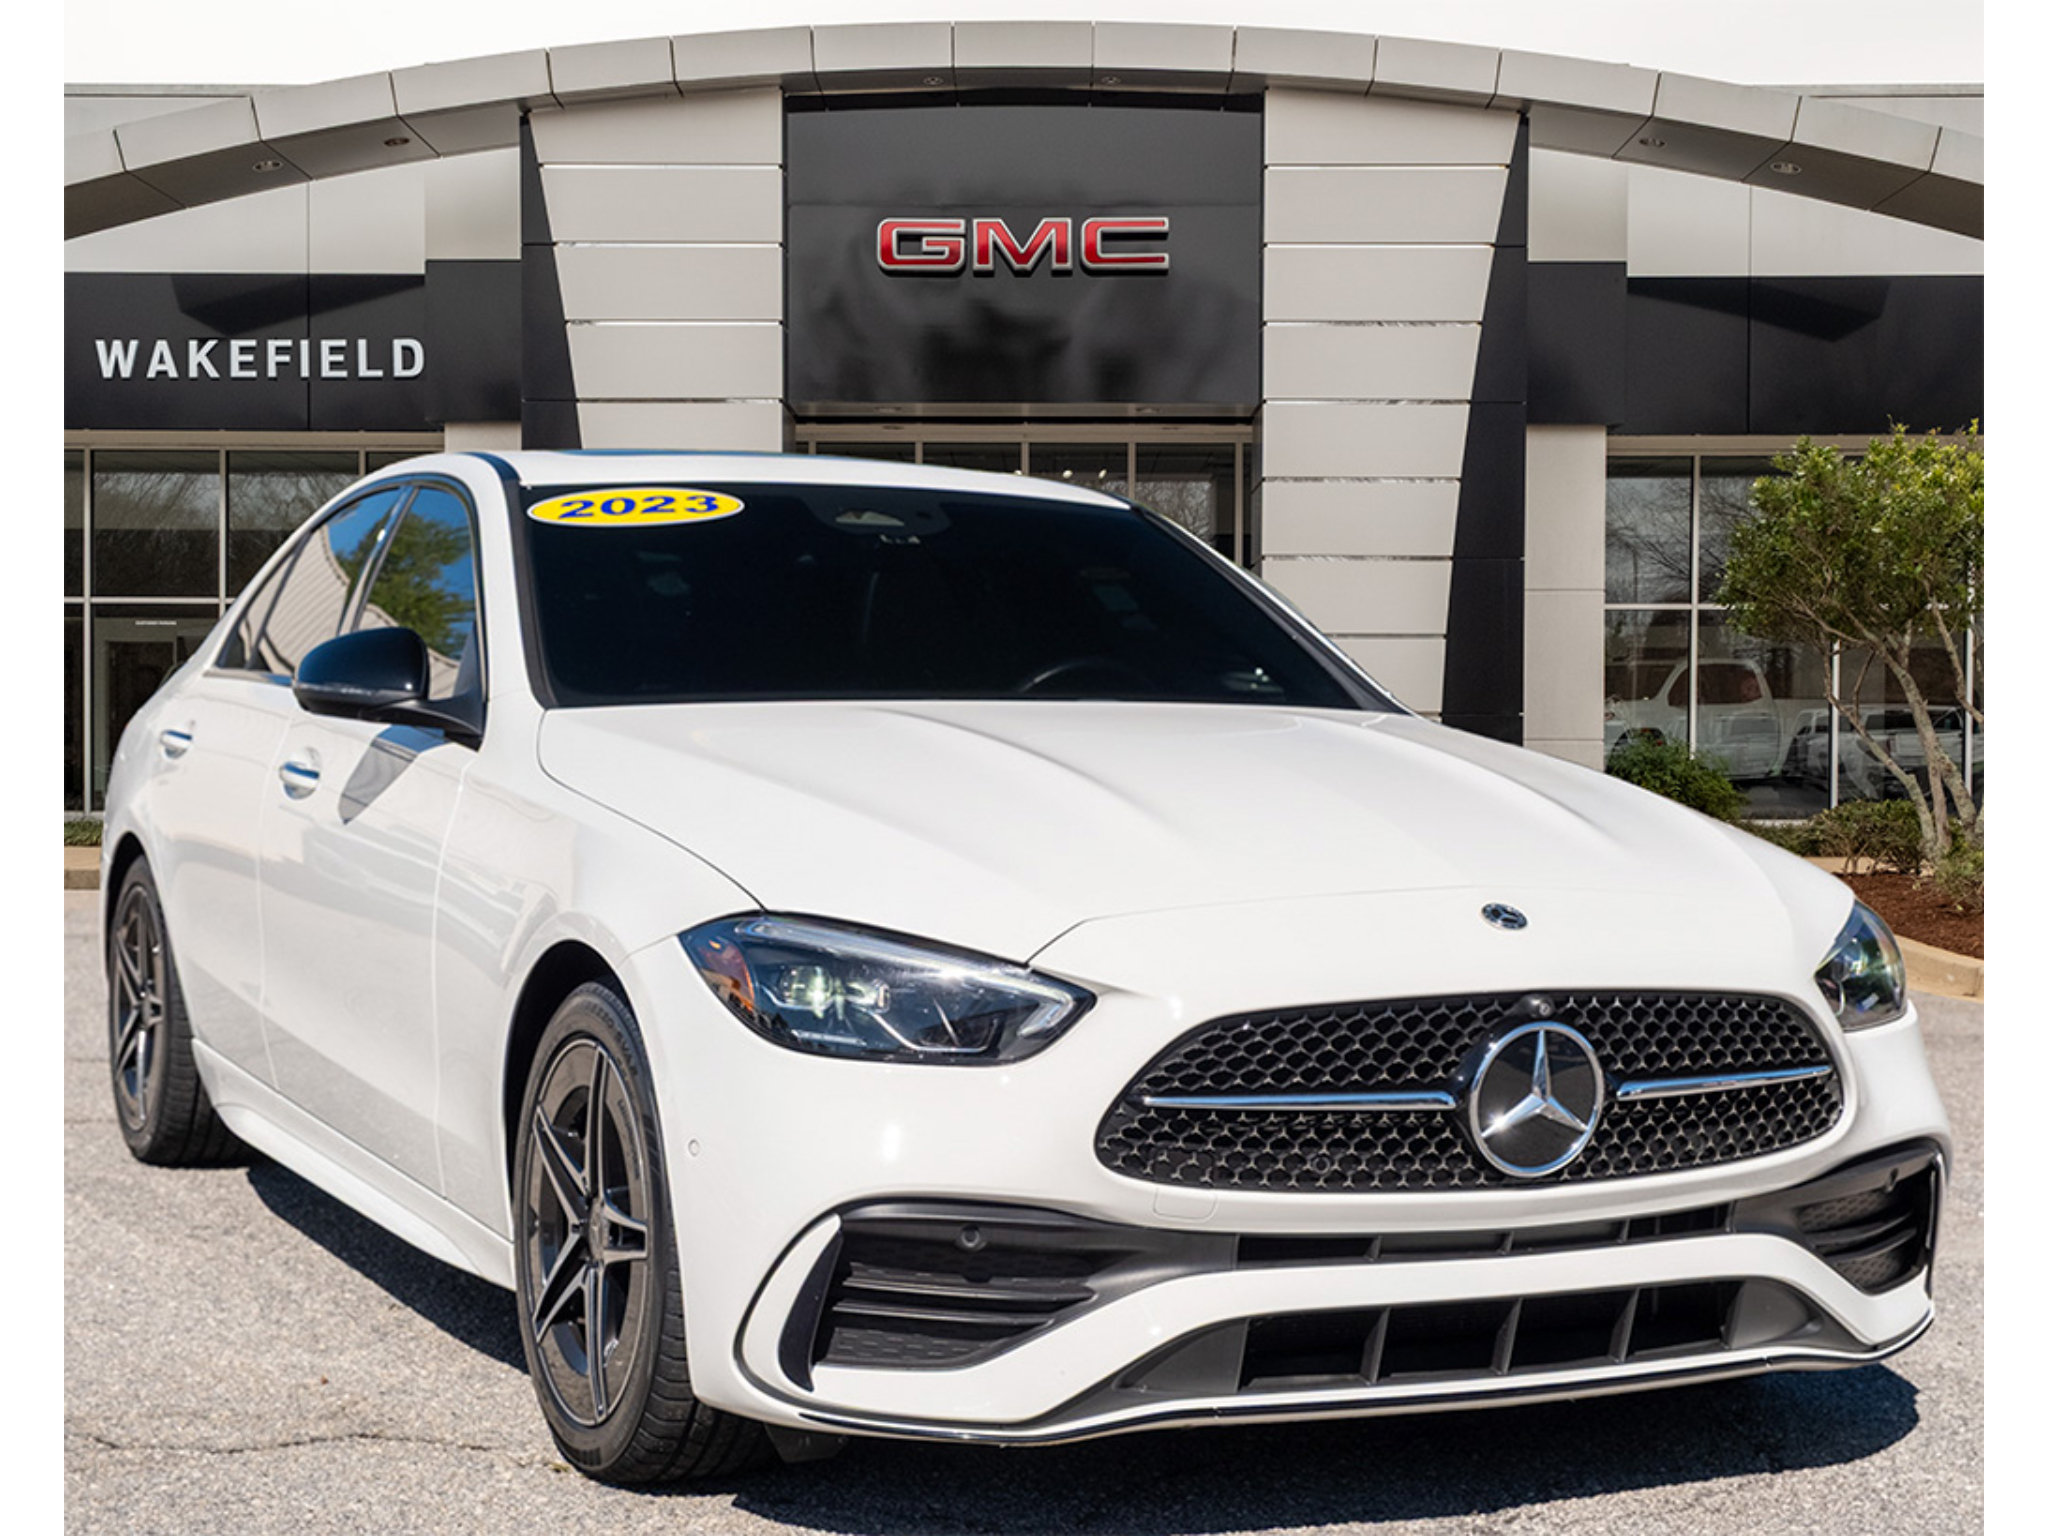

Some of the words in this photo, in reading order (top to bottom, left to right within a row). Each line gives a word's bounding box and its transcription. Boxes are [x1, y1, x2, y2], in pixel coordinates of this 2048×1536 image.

[877, 217, 1169, 272] GMC
[95, 338, 426, 379] WAKEFIELD
[558, 495, 719, 519] 2023
